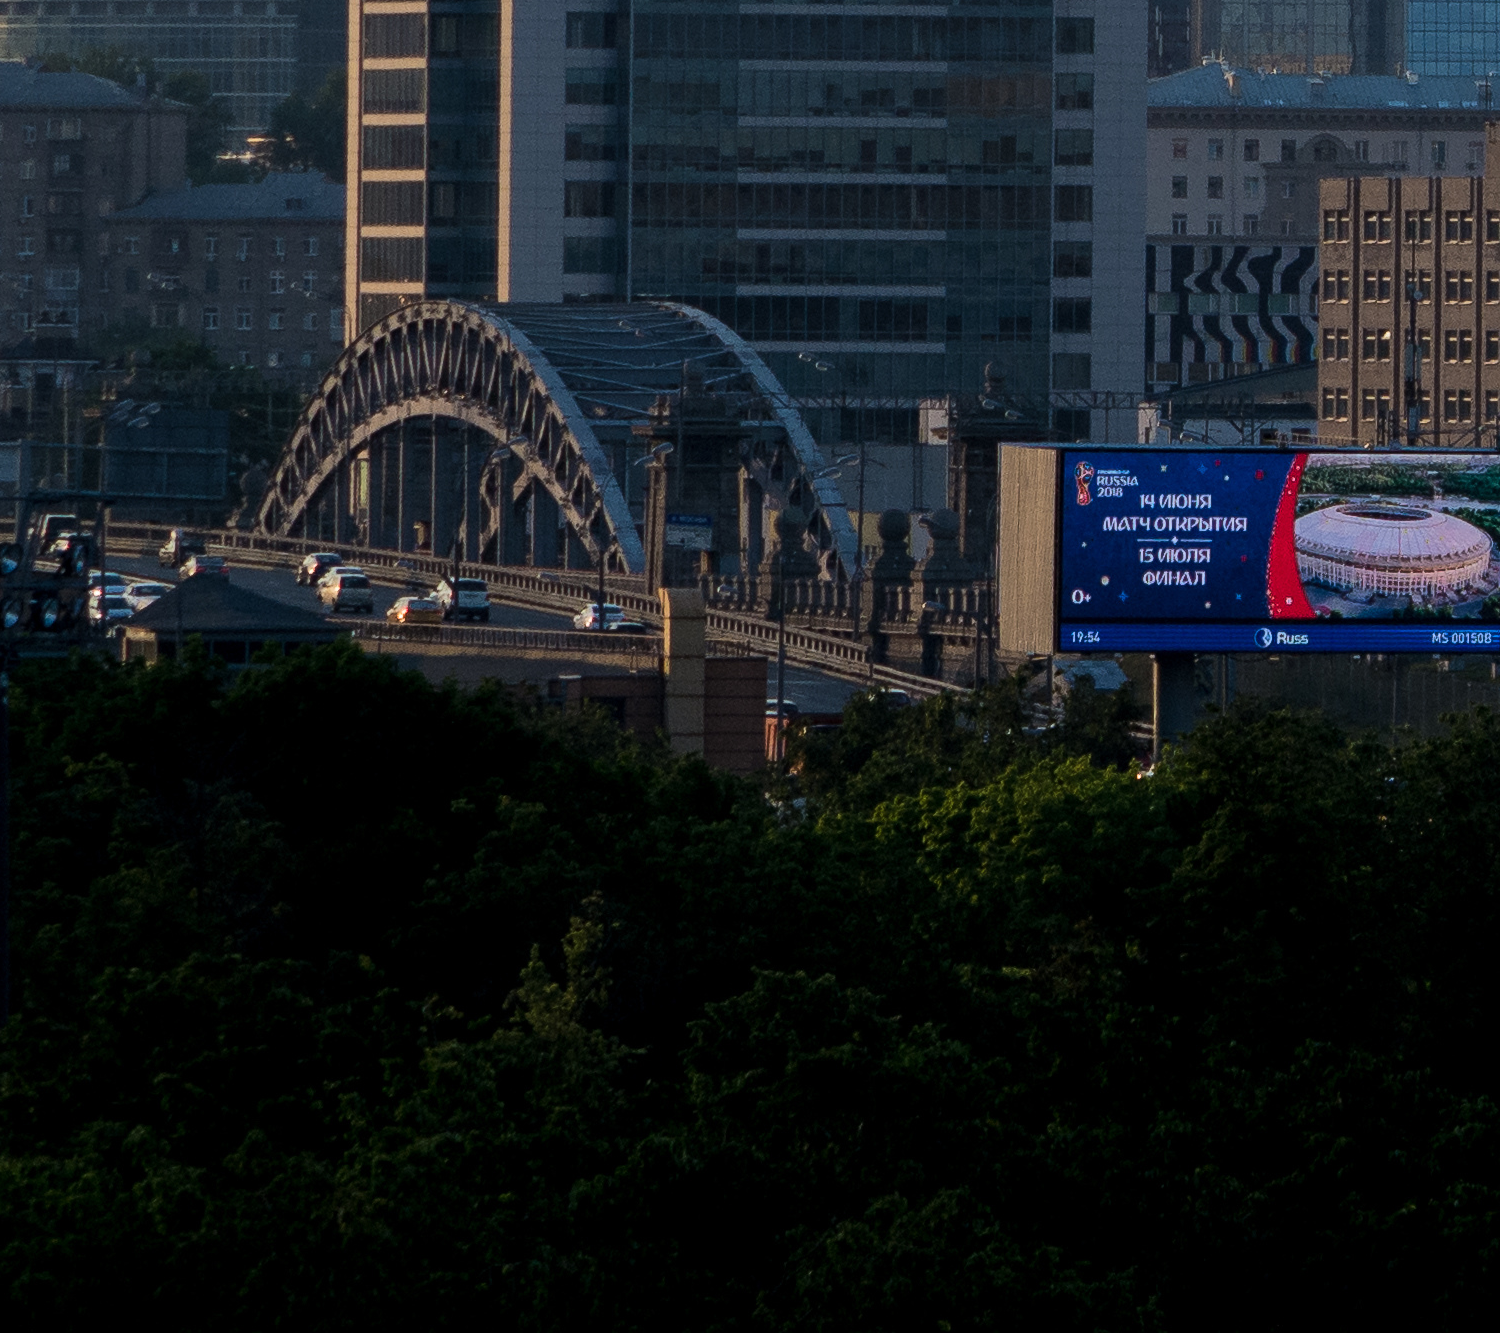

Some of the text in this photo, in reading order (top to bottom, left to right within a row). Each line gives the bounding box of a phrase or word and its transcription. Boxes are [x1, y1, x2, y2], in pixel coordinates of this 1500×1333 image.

[1096, 475, 1139, 486] RUSSIA
[1097, 486, 1123, 498] 2018
[1139, 493, 1212, 509] 14 ИЮНЯ
[1102, 516, 1248, 532] МАТЧ ОТКРЫТИЯ
[1138, 547, 1211, 563] 15 ИЮЛЯ
[1142, 569, 1206, 586] ФИНАЛ
[1071, 588, 1092, 605] 0+
[1070, 630, 1100, 643] 19:54
[1276, 631, 1309, 645] Russ
[1431, 632, 1449, 644] MS
